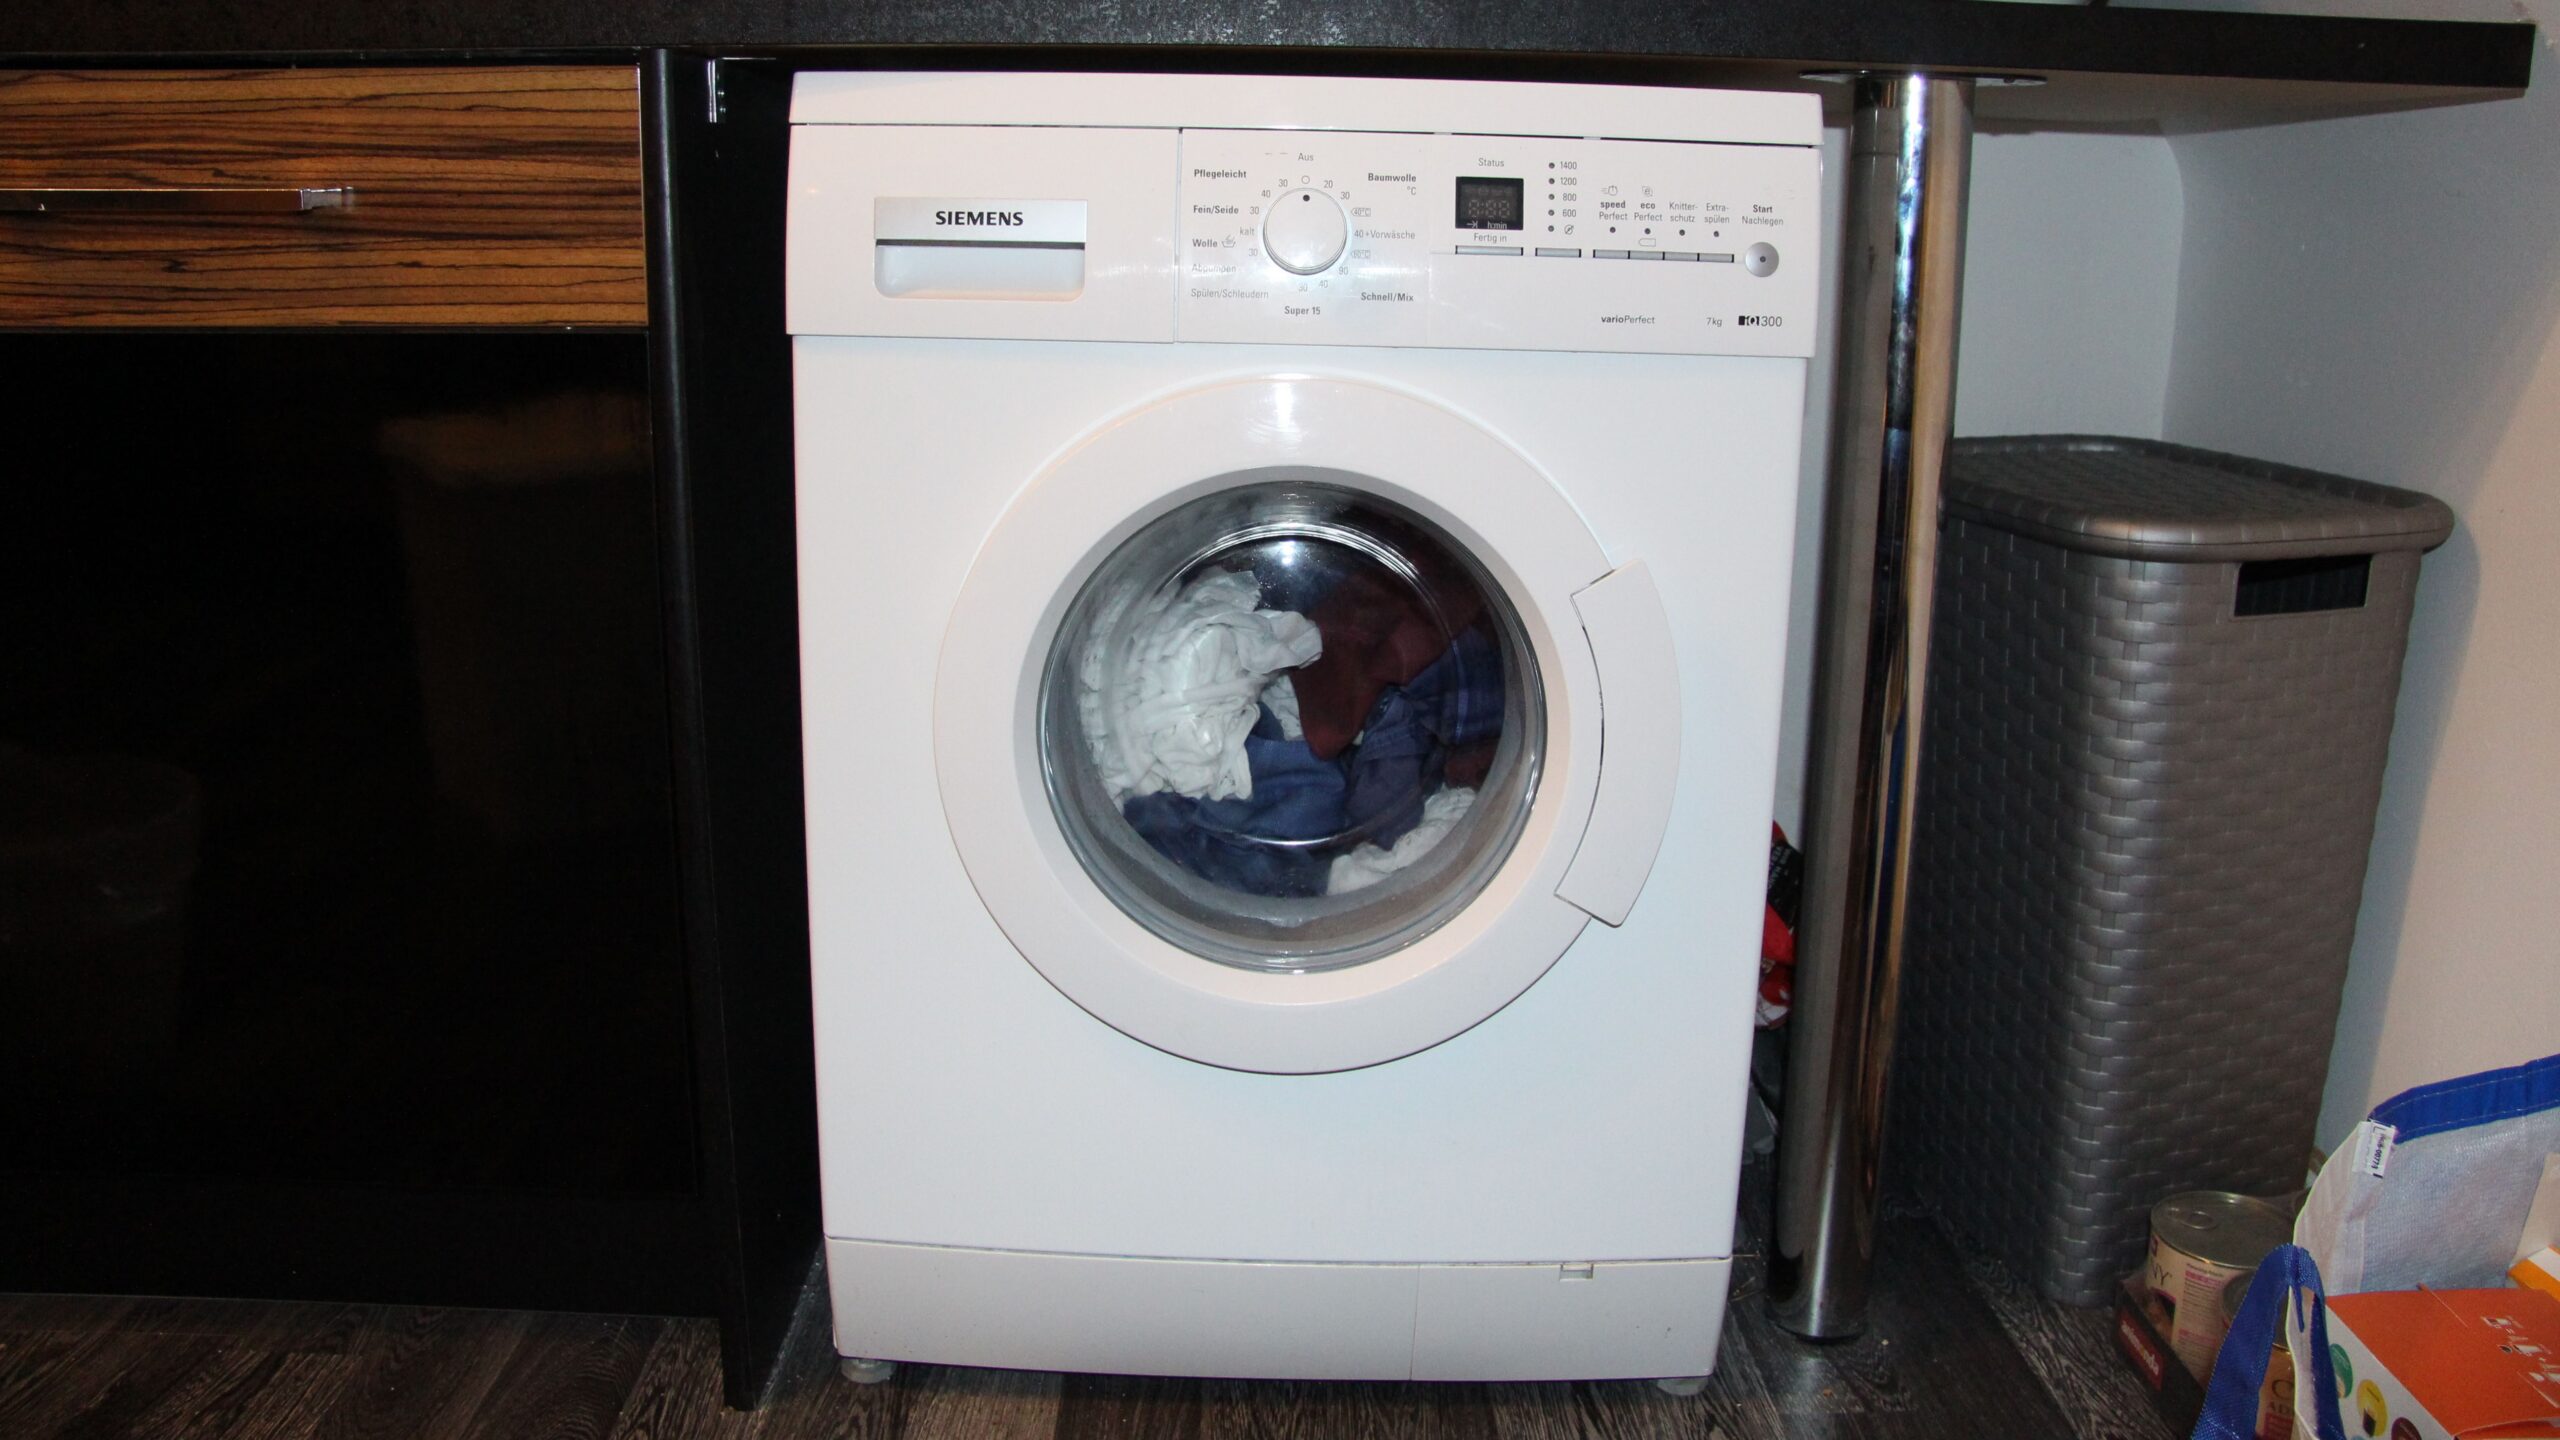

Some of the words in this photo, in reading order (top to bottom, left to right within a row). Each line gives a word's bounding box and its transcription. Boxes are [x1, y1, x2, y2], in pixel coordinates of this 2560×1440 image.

[1297, 152, 1314, 161] Aus
[1478, 158, 1505, 168] Status
[1560, 161, 1578, 170] 1400
[1193, 168, 1247, 180] Pflegeleicht
[1367, 173, 1417, 183] Baumwolle
[1278, 179, 1288, 188] 30
[1323, 180, 1334, 189] 20
[1560, 176, 1578, 186] 1200
[1261, 190, 1271, 199] 40
[1340, 191, 1350, 200] 30
[1562, 193, 1578, 202] 800
[1193, 205, 1239, 214] Fein/Seide
[1249, 206, 1260, 215] 30
[1600, 201, 1626, 212] speed
[1640, 202, 1656, 211] eco
[1669, 202, 1699, 213] Knitter-
[1752, 205, 1774, 214] Start
[935, 211, 1024, 226] SIEMENS
[1562, 209, 1578, 218] 600
[1599, 212, 1628, 222] Perfect
[1633, 213, 1663, 222] Perfect
[1669, 213, 1696, 223] schutz
[1704, 214, 1730, 226] spülen
[1741, 216, 1784, 227] Nachlegen
[1239, 227, 1255, 236] kalt
[1192, 238, 1218, 248] Wolle
[1473, 233, 1496, 244] Fertig
[1498, 233, 1508, 243] in
[1248, 248, 1258, 257] 30
[1319, 280, 1329, 289] 40
[1190, 288, 1269, 300] Spülen/Schleudern
[1361, 292, 1414, 302] Schnell/Mix
[1284, 305, 1309, 316] Super
[1311, 306, 1321, 315] 15
[1600, 314, 1656, 325] varioPerfect
